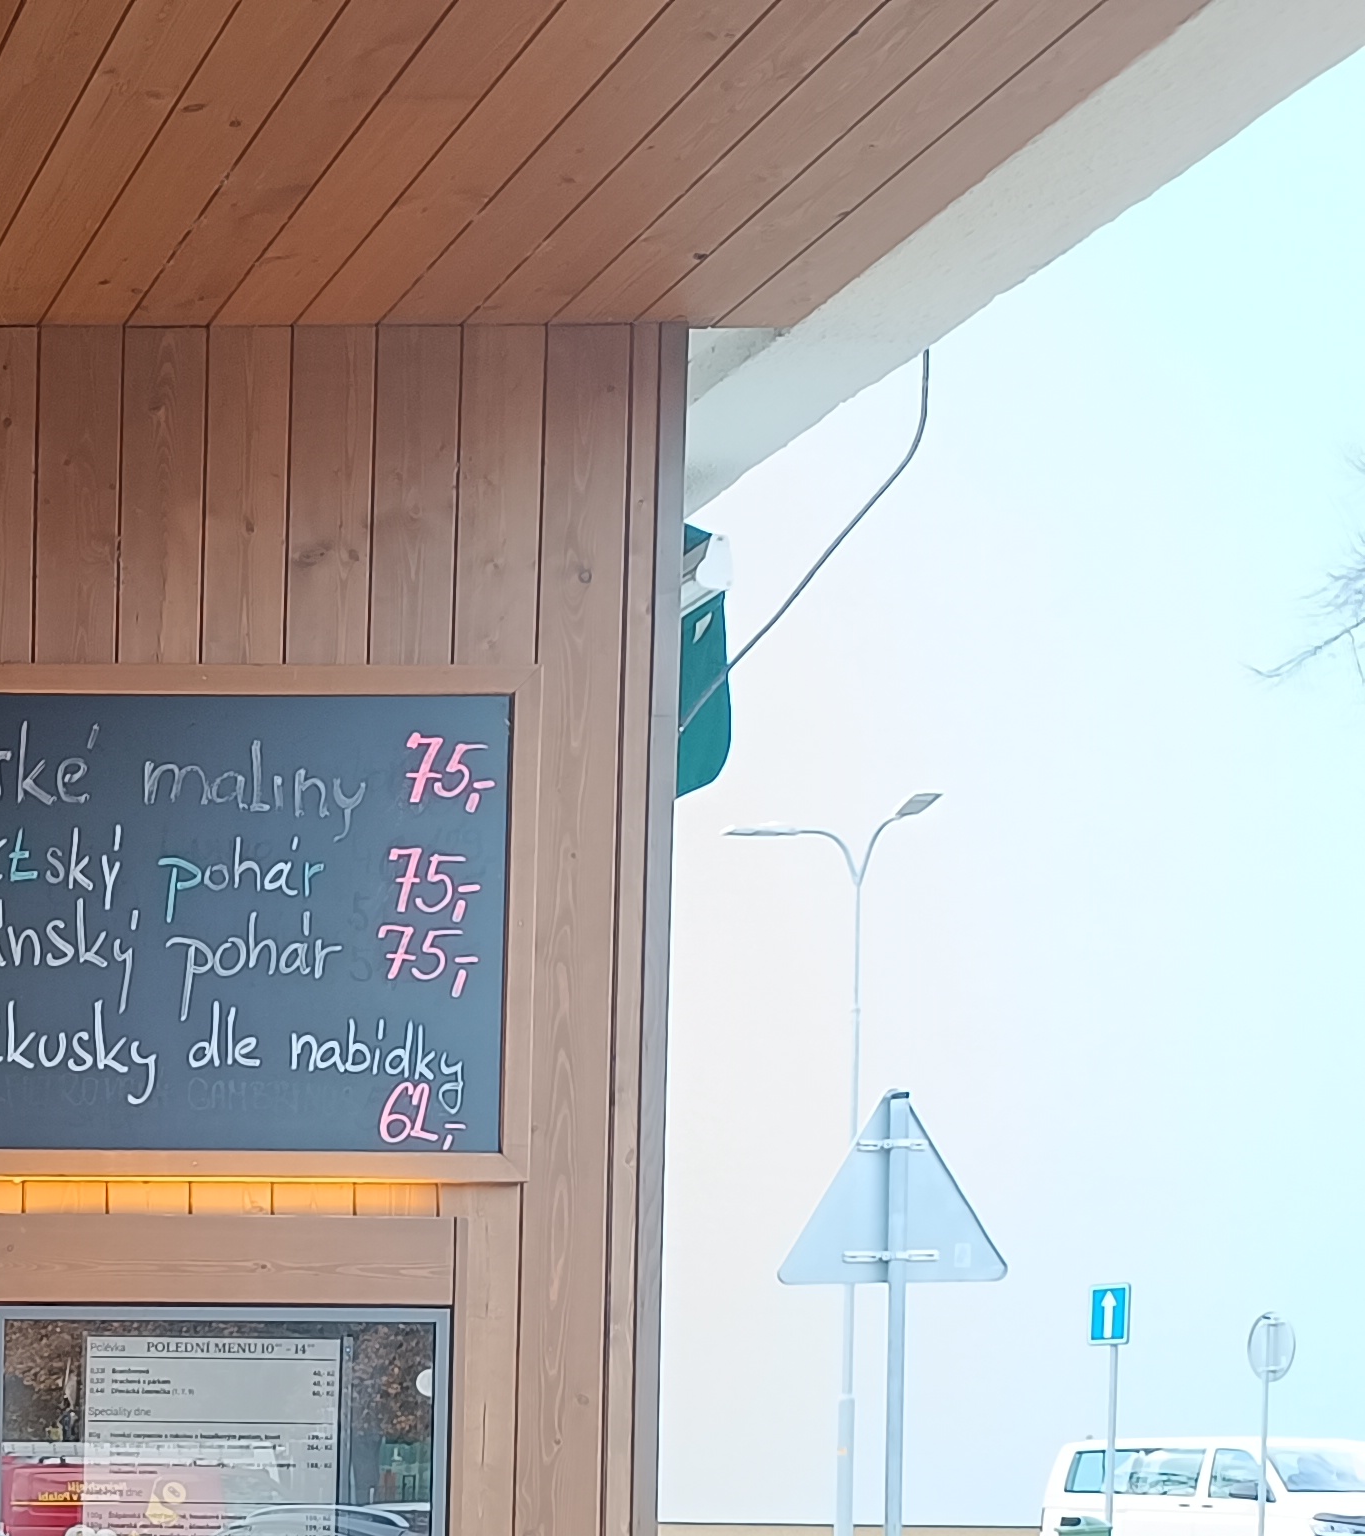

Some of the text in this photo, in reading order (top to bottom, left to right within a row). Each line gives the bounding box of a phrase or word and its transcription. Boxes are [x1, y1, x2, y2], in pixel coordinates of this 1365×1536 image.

[142, 738, 367, 842] maliny
[405, 731, 496, 813] 75,-
[157, 835, 325, 923] pohár
[386, 846, 482, 923] 75,-
[165, 911, 343, 1021] pohár
[376, 924, 479, 998] 75,-
[187, 1000, 262, 1070] dle
[288, 1017, 466, 1115] nabídky
[147, 1341, 211, 1354] POLEDNÍ
[214, 1342, 258, 1354] MENU
